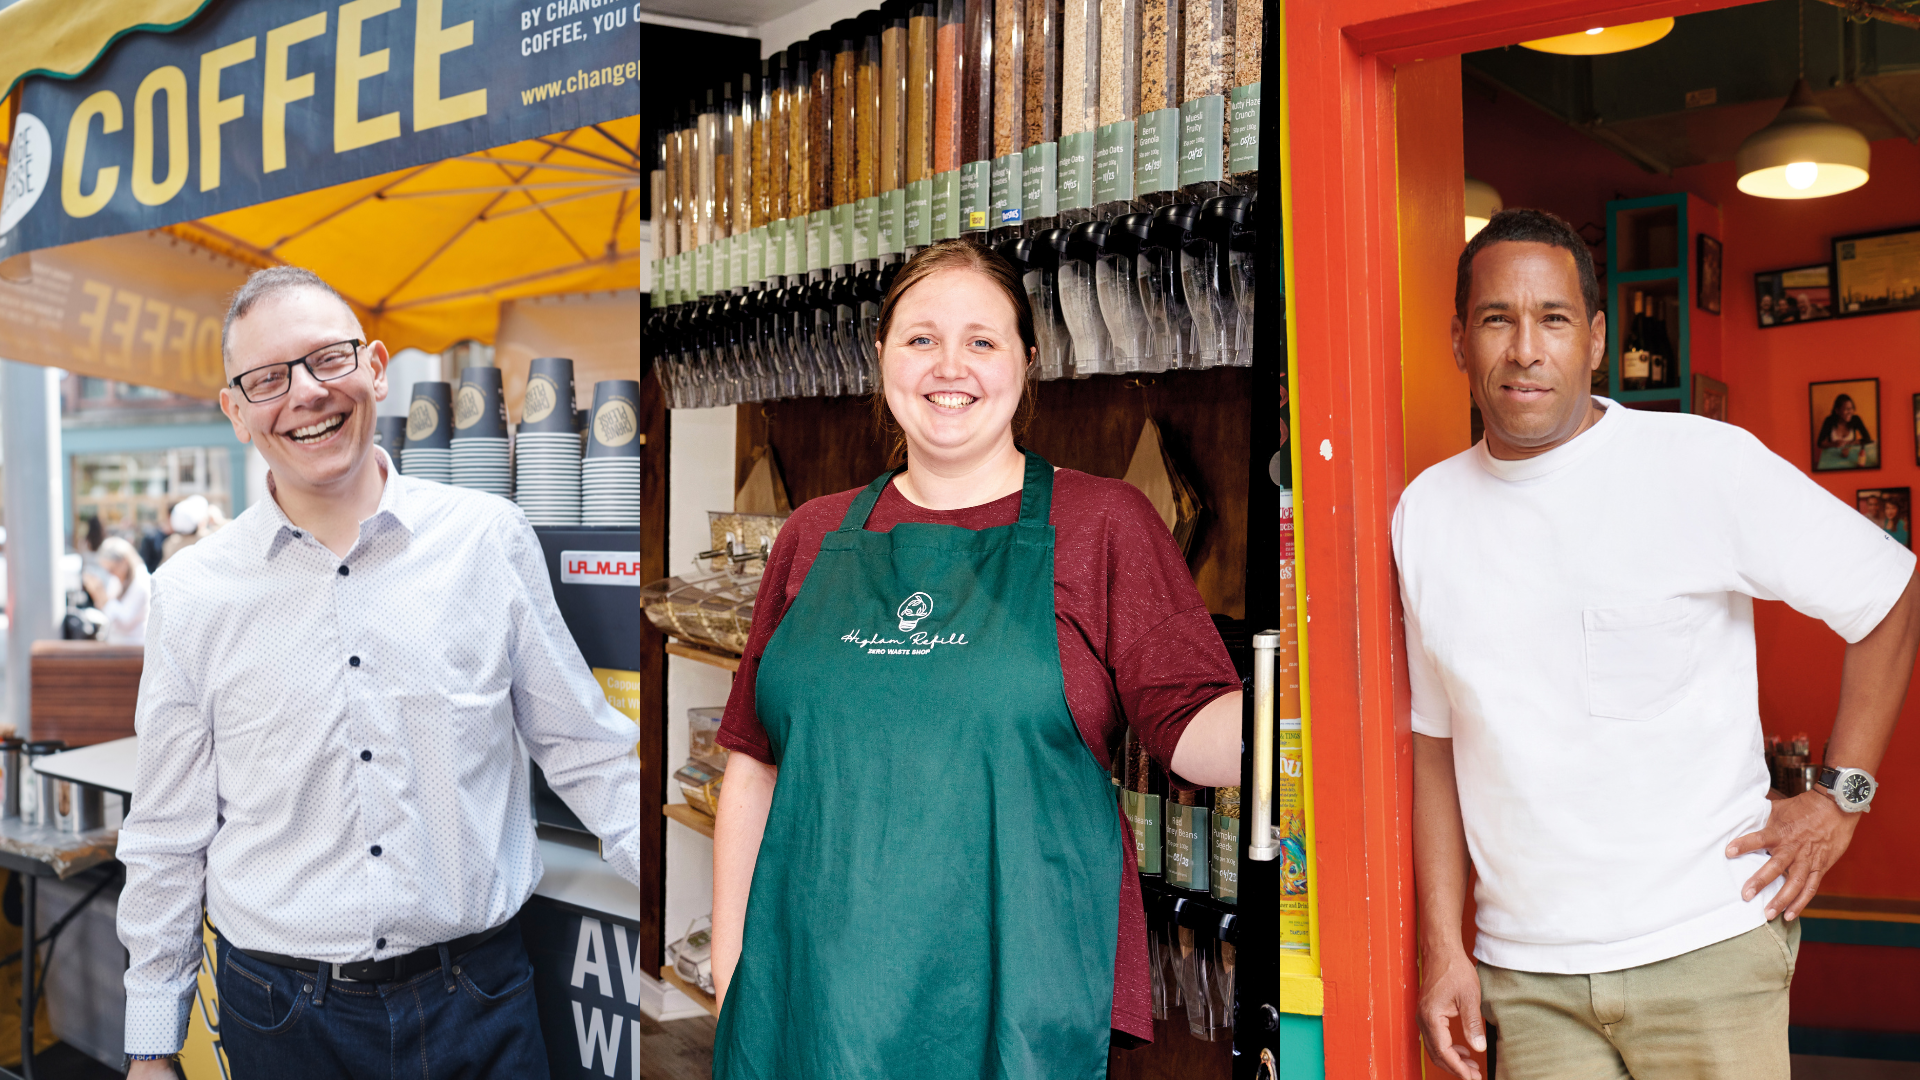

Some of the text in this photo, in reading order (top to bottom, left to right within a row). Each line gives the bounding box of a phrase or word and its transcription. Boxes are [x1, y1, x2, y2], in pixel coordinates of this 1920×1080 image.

[521, 0, 619, 31] BY CHAN
[521, 21, 587, 57] COFFEE,
[593, 7, 626, 35] YOU
[521, 60, 640, 106] www.change
[61, 0, 487, 218] COFFEE
[1185, 111, 1203, 123] Muesli
[1235, 109, 1256, 121] Crunch
[1142, 126, 1156, 136] Berry
[1186, 123, 1202, 133] Fruity
[1140, 135, 1159, 146] Granola
[1109, 145, 1124, 154] Oats
[1071, 155, 1085, 164] Oats
[1029, 165, 1045, 175] Flakes
[598, 405, 629, 430] PLEASE
[602, 419, 633, 443] CHANGE
[909, 631, 968, 649] Refill
[1285, 732, 1300, 740] TINGS
[1134, 815, 1153, 826] Beans
[1172, 816, 1183, 826] Red
[1178, 829, 1198, 840] Beans
[1216, 839, 1232, 852] Seeds
